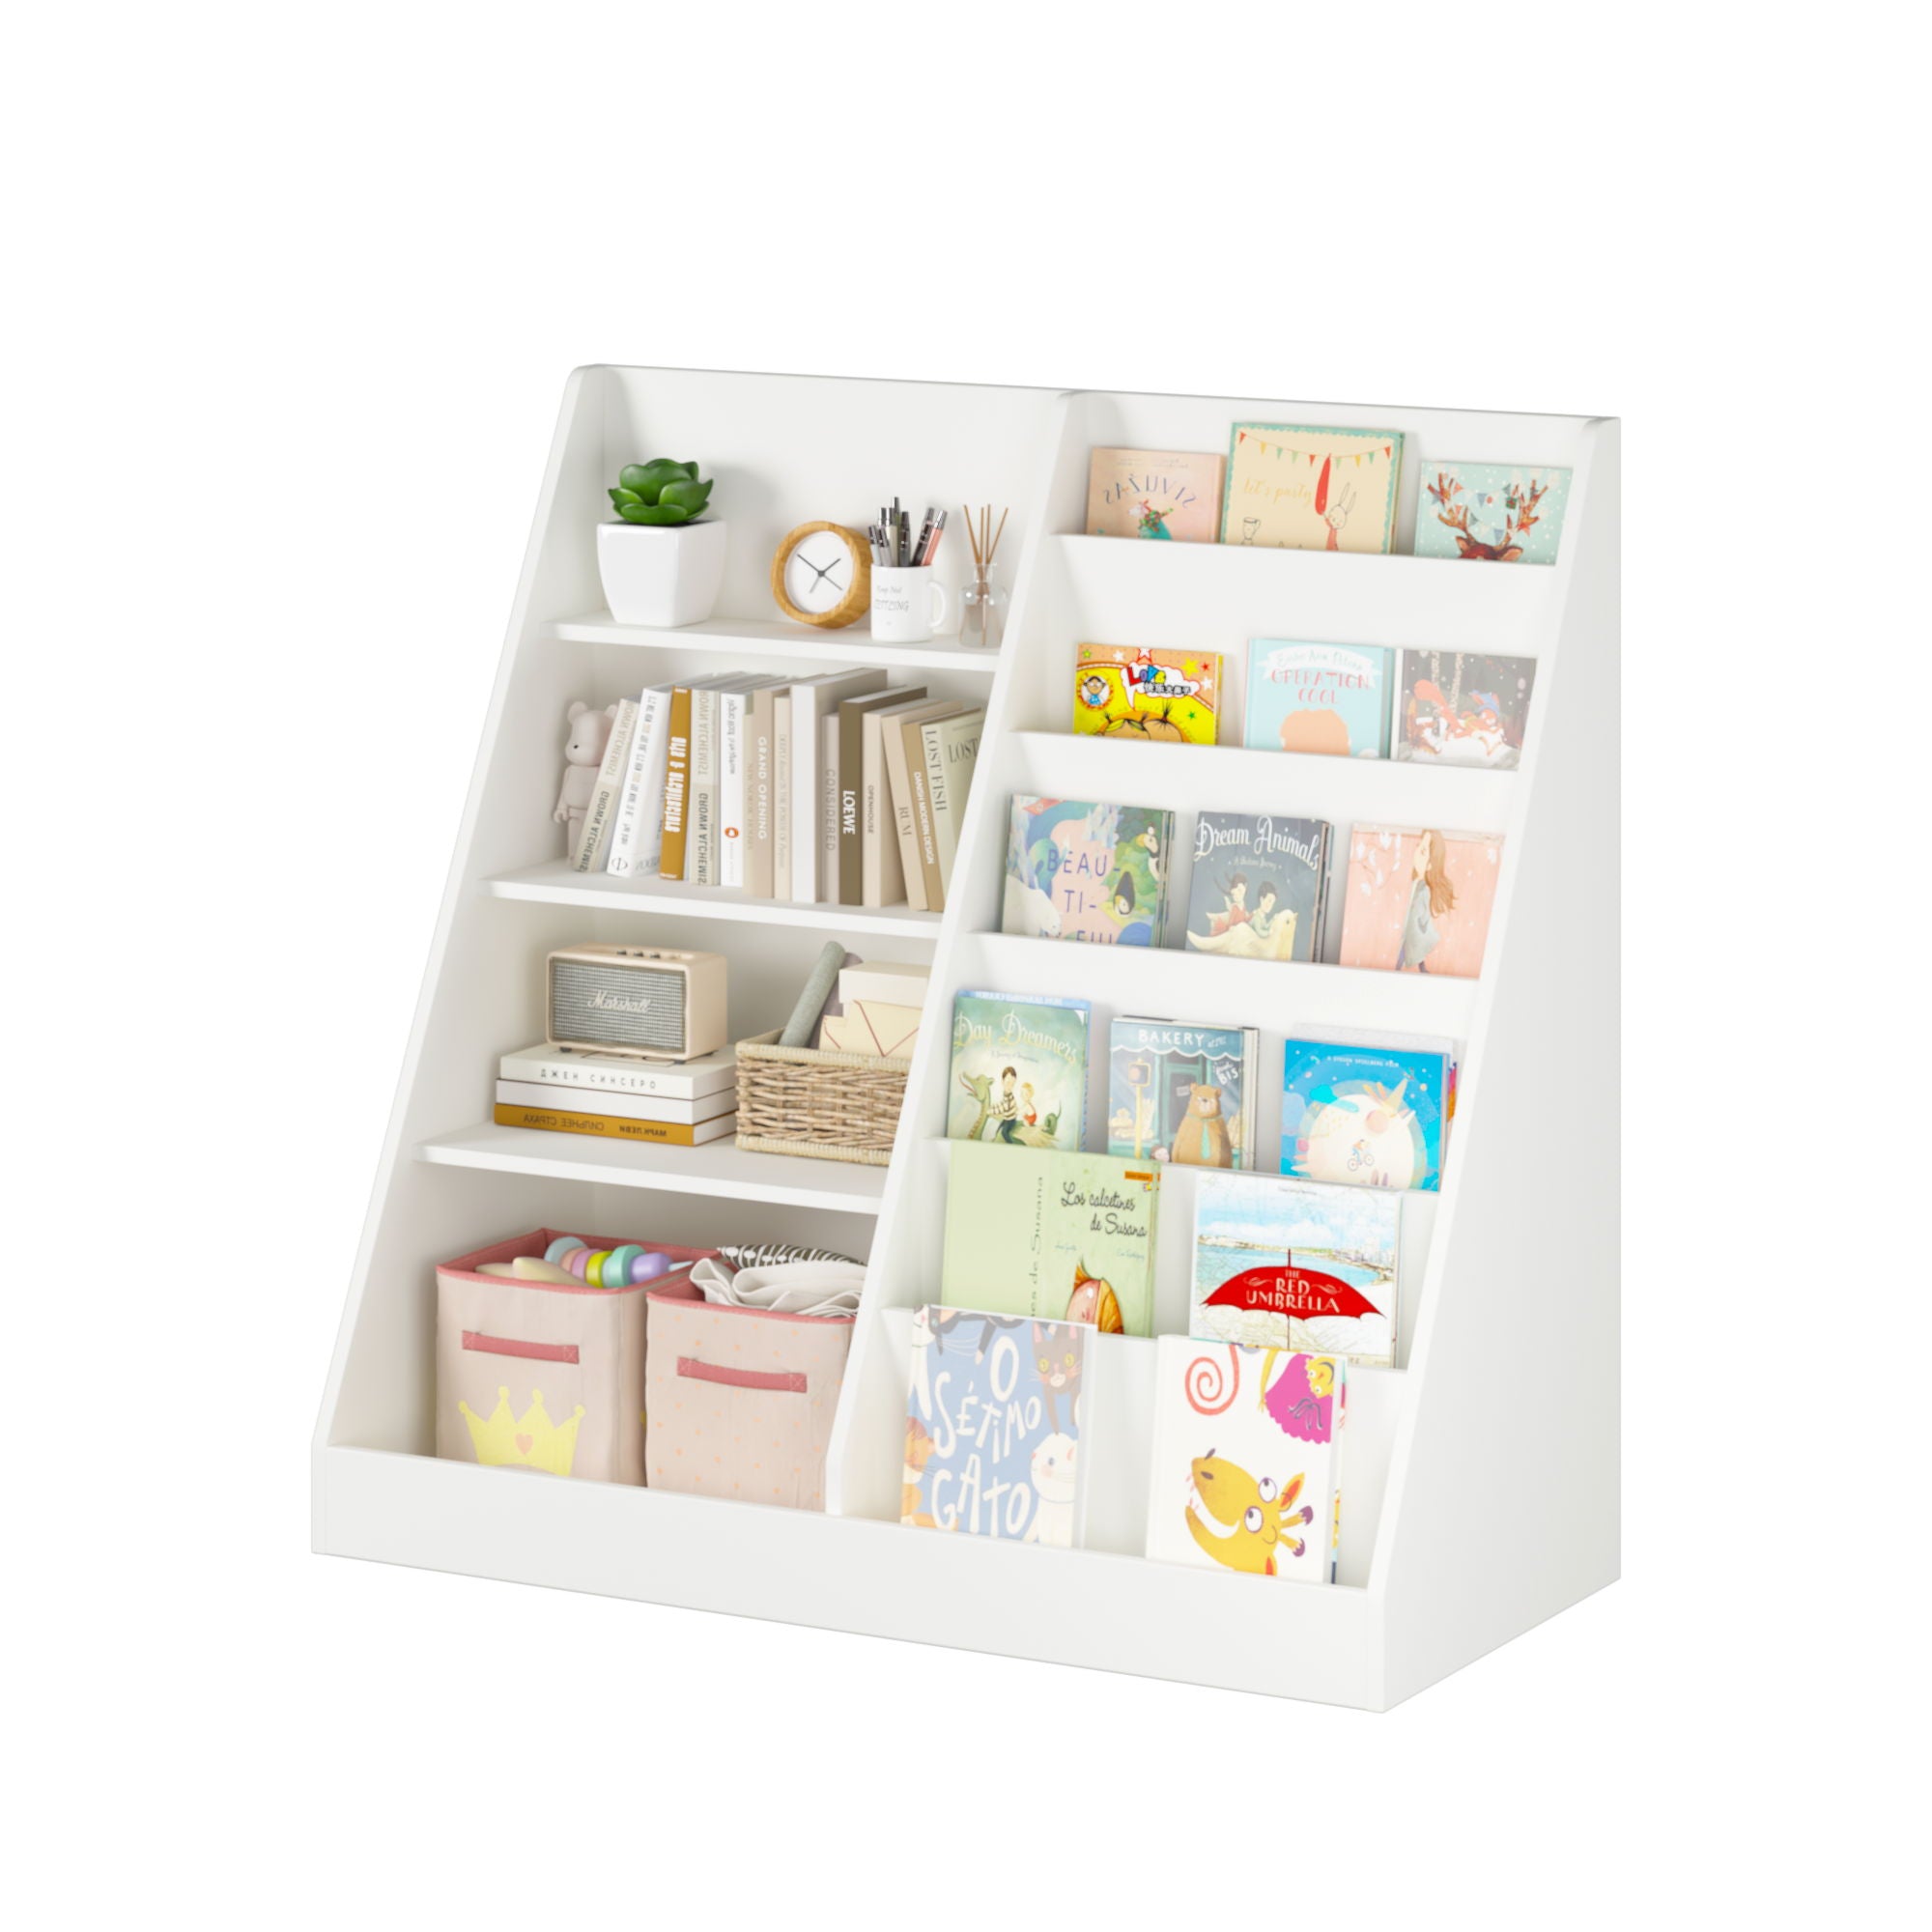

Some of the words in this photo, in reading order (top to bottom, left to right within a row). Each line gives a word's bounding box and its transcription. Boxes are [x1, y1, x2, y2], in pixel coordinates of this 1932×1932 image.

[1273, 483, 1312, 508] party
[1271, 668, 1370, 690] OPERATION
[1297, 688, 1337, 703] COOL
[757, 736, 767, 780] GRAND
[925, 729, 942, 771] LOST
[948, 738, 979, 763] LOST
[931, 775, 948, 811] FISH
[757, 783, 767, 839] OPENING
[826, 768, 837, 851] CONSIDERED
[842, 790, 856, 835] LOEWE
[1193, 816, 1250, 862] Dream
[1253, 814, 1320, 871] Animals
[1047, 849, 1121, 877] BEAU-
[1064, 889, 1097, 914] TI-
[586, 989, 651, 1013] Marshall
[952, 1009, 993, 1051] Day
[999, 1008, 1078, 1065] Dreamers
[1138, 1029, 1206, 1048] BAKERY
[540, 1068, 580, 1080] ДЖЕН
[589, 1074, 657, 1089] СИНСЕРО
[1061, 1180, 1086, 1207] Los
[1089, 1187, 1136, 1211] calcetines
[1090, 1212, 1102, 1231] de
[1104, 1212, 1148, 1236] Susana
[1275, 1277, 1310, 1295] RED
[1245, 1290, 1341, 1313] UMBRELLA
[989, 1335, 1019, 1402] O
[931, 1453, 1031, 1538] GATO
